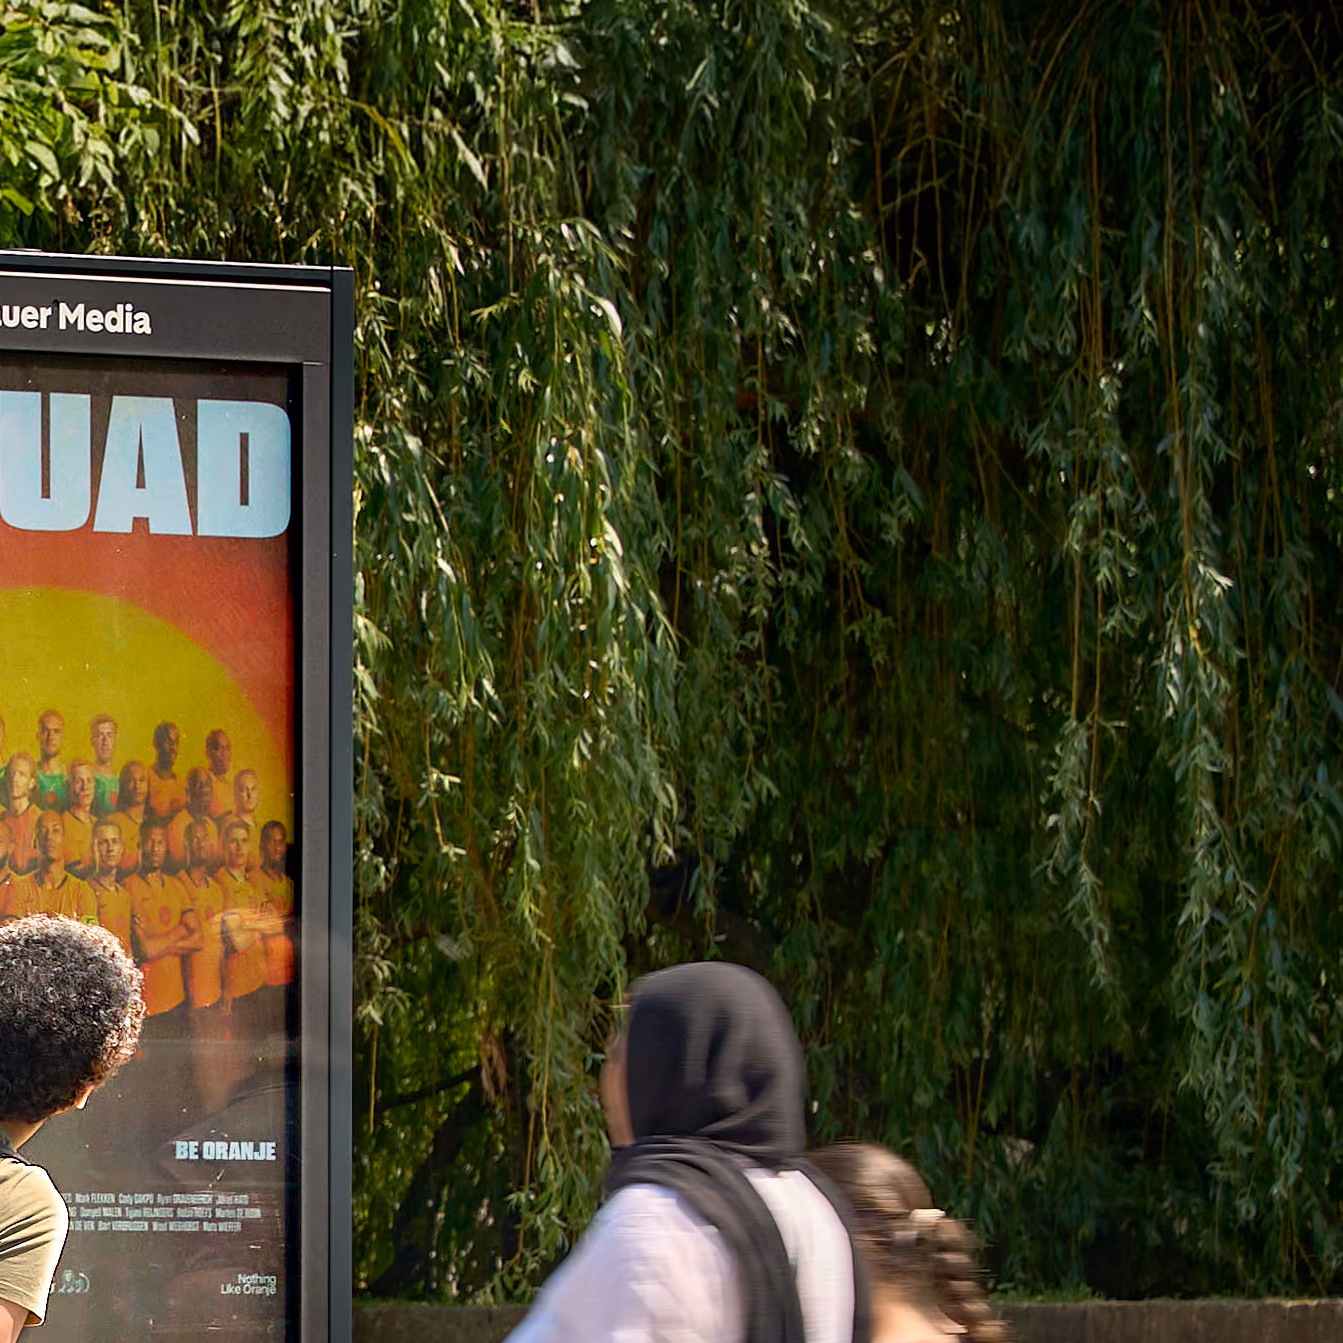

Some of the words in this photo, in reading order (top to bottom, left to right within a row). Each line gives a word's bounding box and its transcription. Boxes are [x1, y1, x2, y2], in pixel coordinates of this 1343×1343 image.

[59, 302, 152, 334] Media
[175, 1141, 199, 1160] BE
[203, 1141, 276, 1160] ORANJE
[238, 1273, 276, 1288] Nothing
[221, 1283, 241, 1294] Like
[244, 1283, 276, 1296] Oranje
